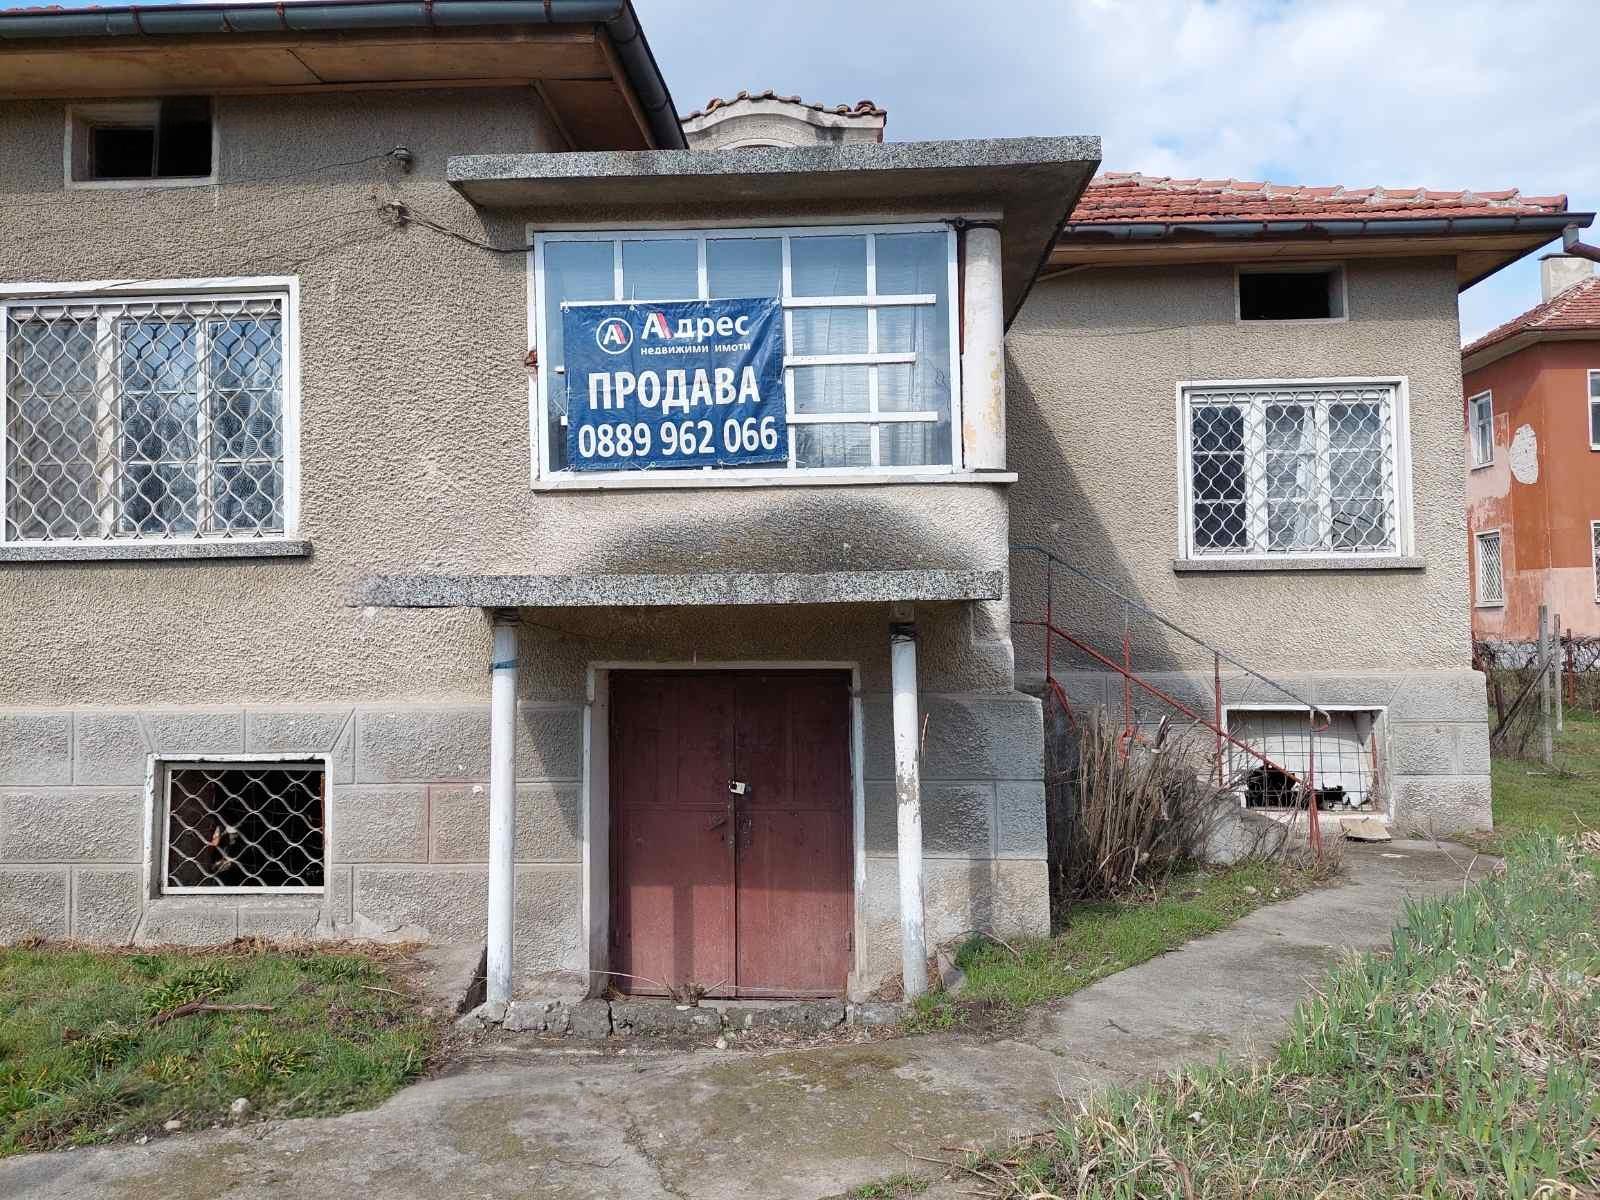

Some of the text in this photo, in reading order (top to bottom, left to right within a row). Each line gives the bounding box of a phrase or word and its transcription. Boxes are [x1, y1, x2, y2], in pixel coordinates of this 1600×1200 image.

[641, 312, 750, 342] Адрес
[640, 343, 751, 356] недвижими имоти
[588, 365, 760, 415] ПРОДАВА
[578, 416, 778, 458] 0889 962 066
